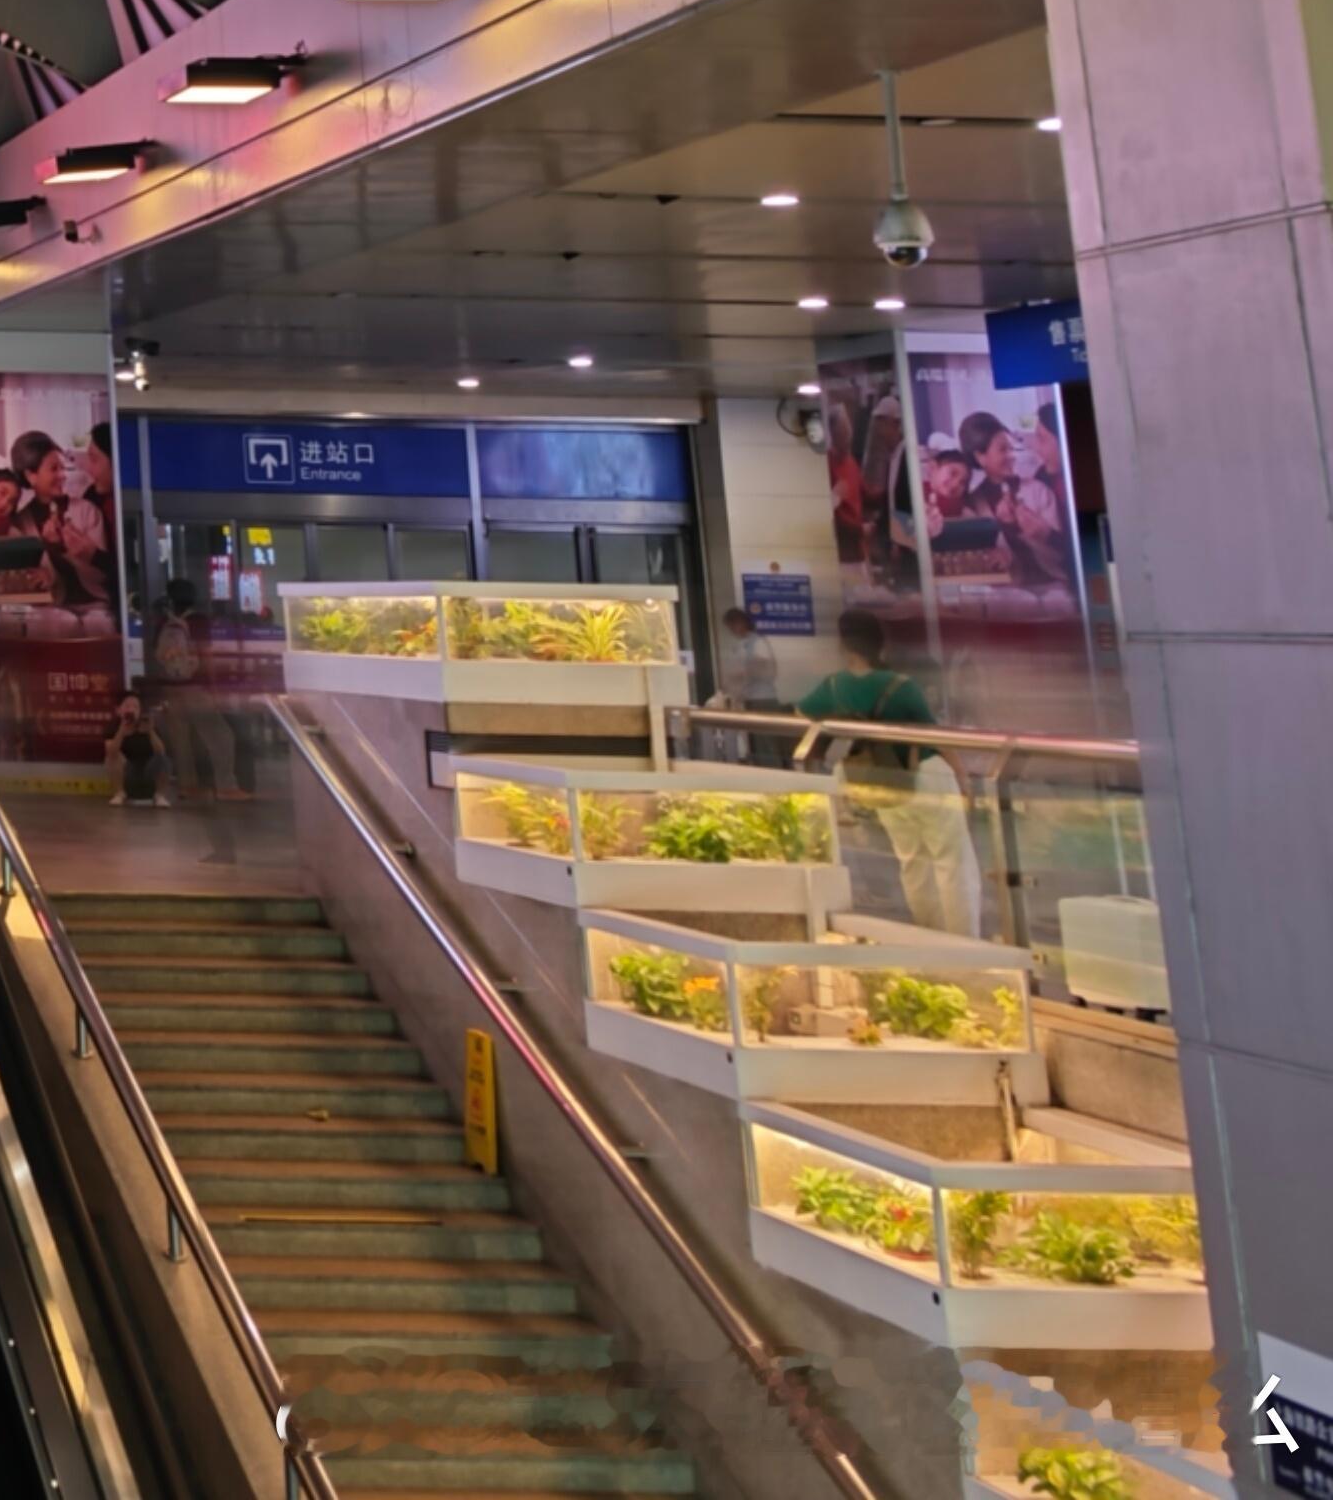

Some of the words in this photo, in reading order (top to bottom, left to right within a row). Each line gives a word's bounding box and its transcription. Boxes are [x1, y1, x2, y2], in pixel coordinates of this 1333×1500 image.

[299, 440, 375, 464] 进站口
[300, 466, 362, 481] Entrance
